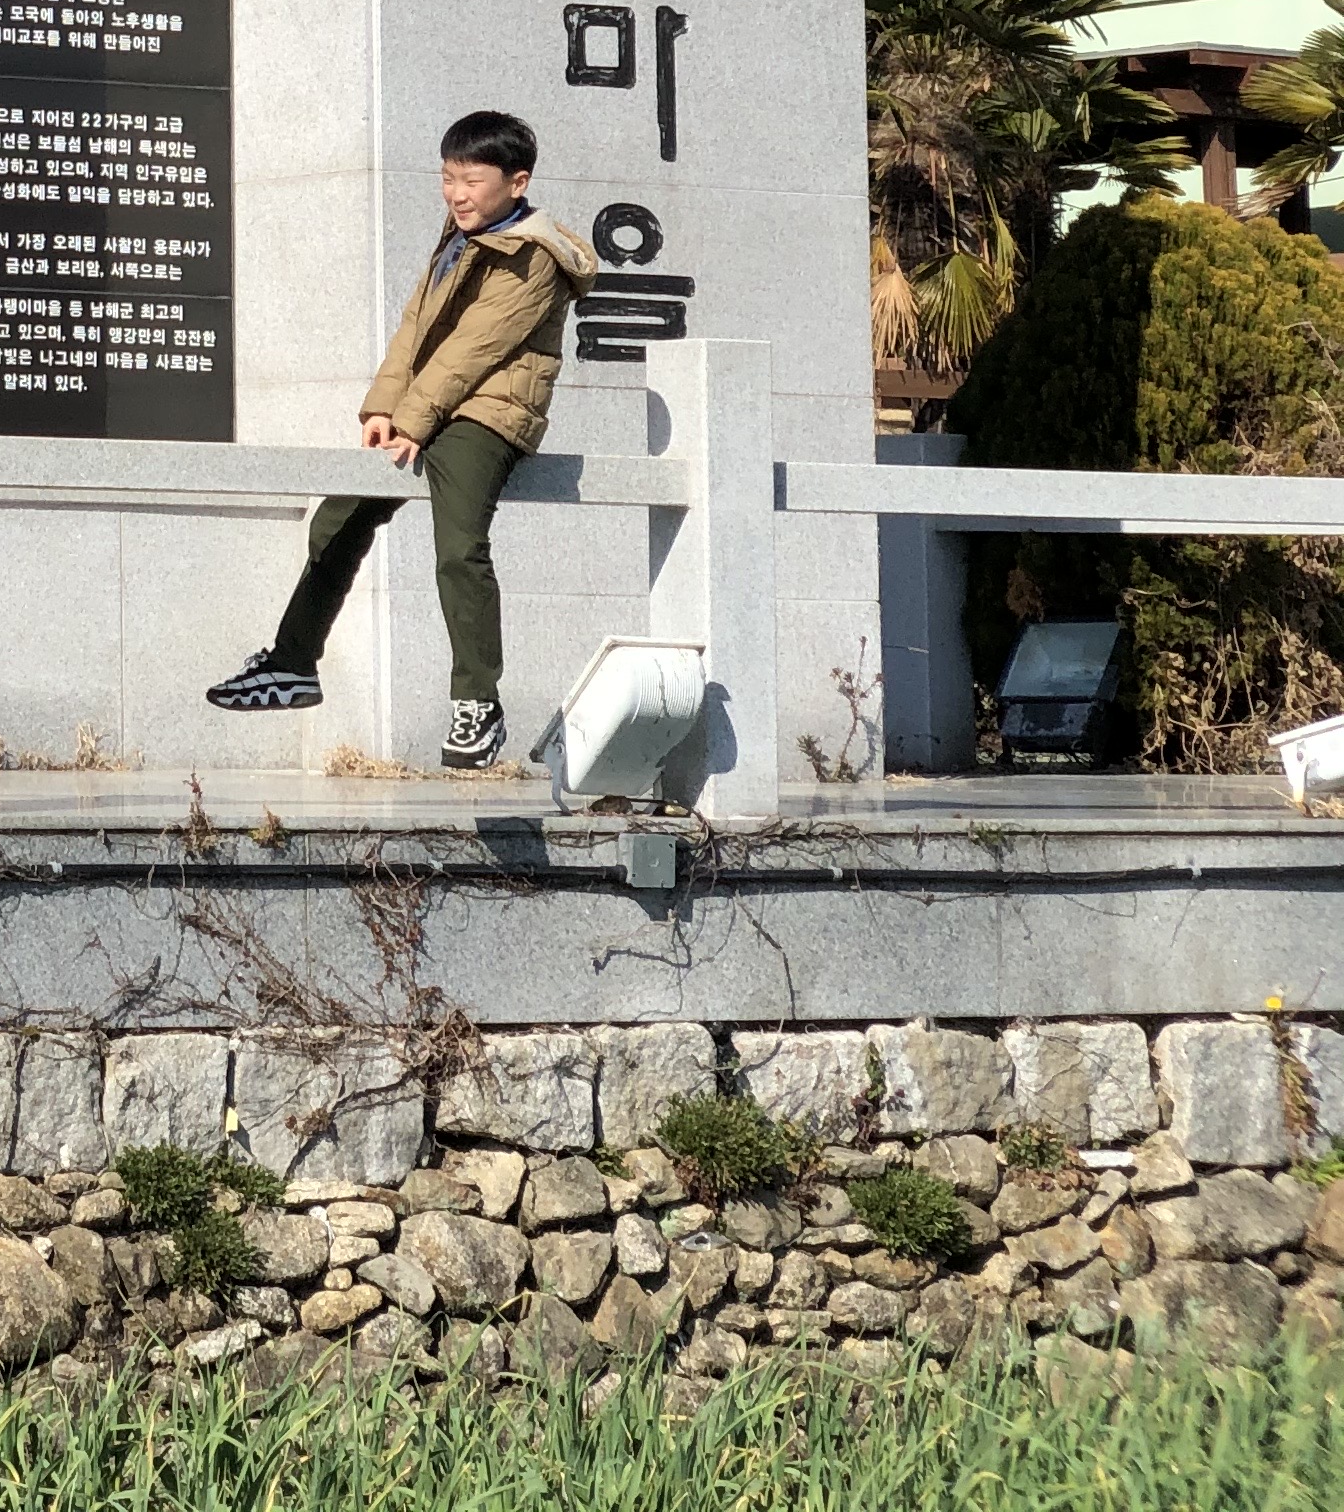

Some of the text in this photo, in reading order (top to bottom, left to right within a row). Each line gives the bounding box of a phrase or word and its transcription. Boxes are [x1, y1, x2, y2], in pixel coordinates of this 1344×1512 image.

[10, 5, 54, 24] 모국에
[60, 8, 105, 28] 돌아와
[110, 11, 183, 32] 노후생활을
[68, 31, 97, 50] 위해
[103, 33, 161, 53] 만들어진
[67, 185, 111, 204] 일익을
[117, 187, 176, 207] 담당하고
[182, 191, 215, 209] 있다.
[69, 300, 83, 318] 등
[90, 301, 134, 320] 남해군
[140, 303, 184, 322] 최고의
[18, 323, 66, 342] 있으며,
[72, 325, 101, 344] 특히
[108, 326, 166, 346] 앵강만의
[173, 329, 216, 348] 잔잔한
